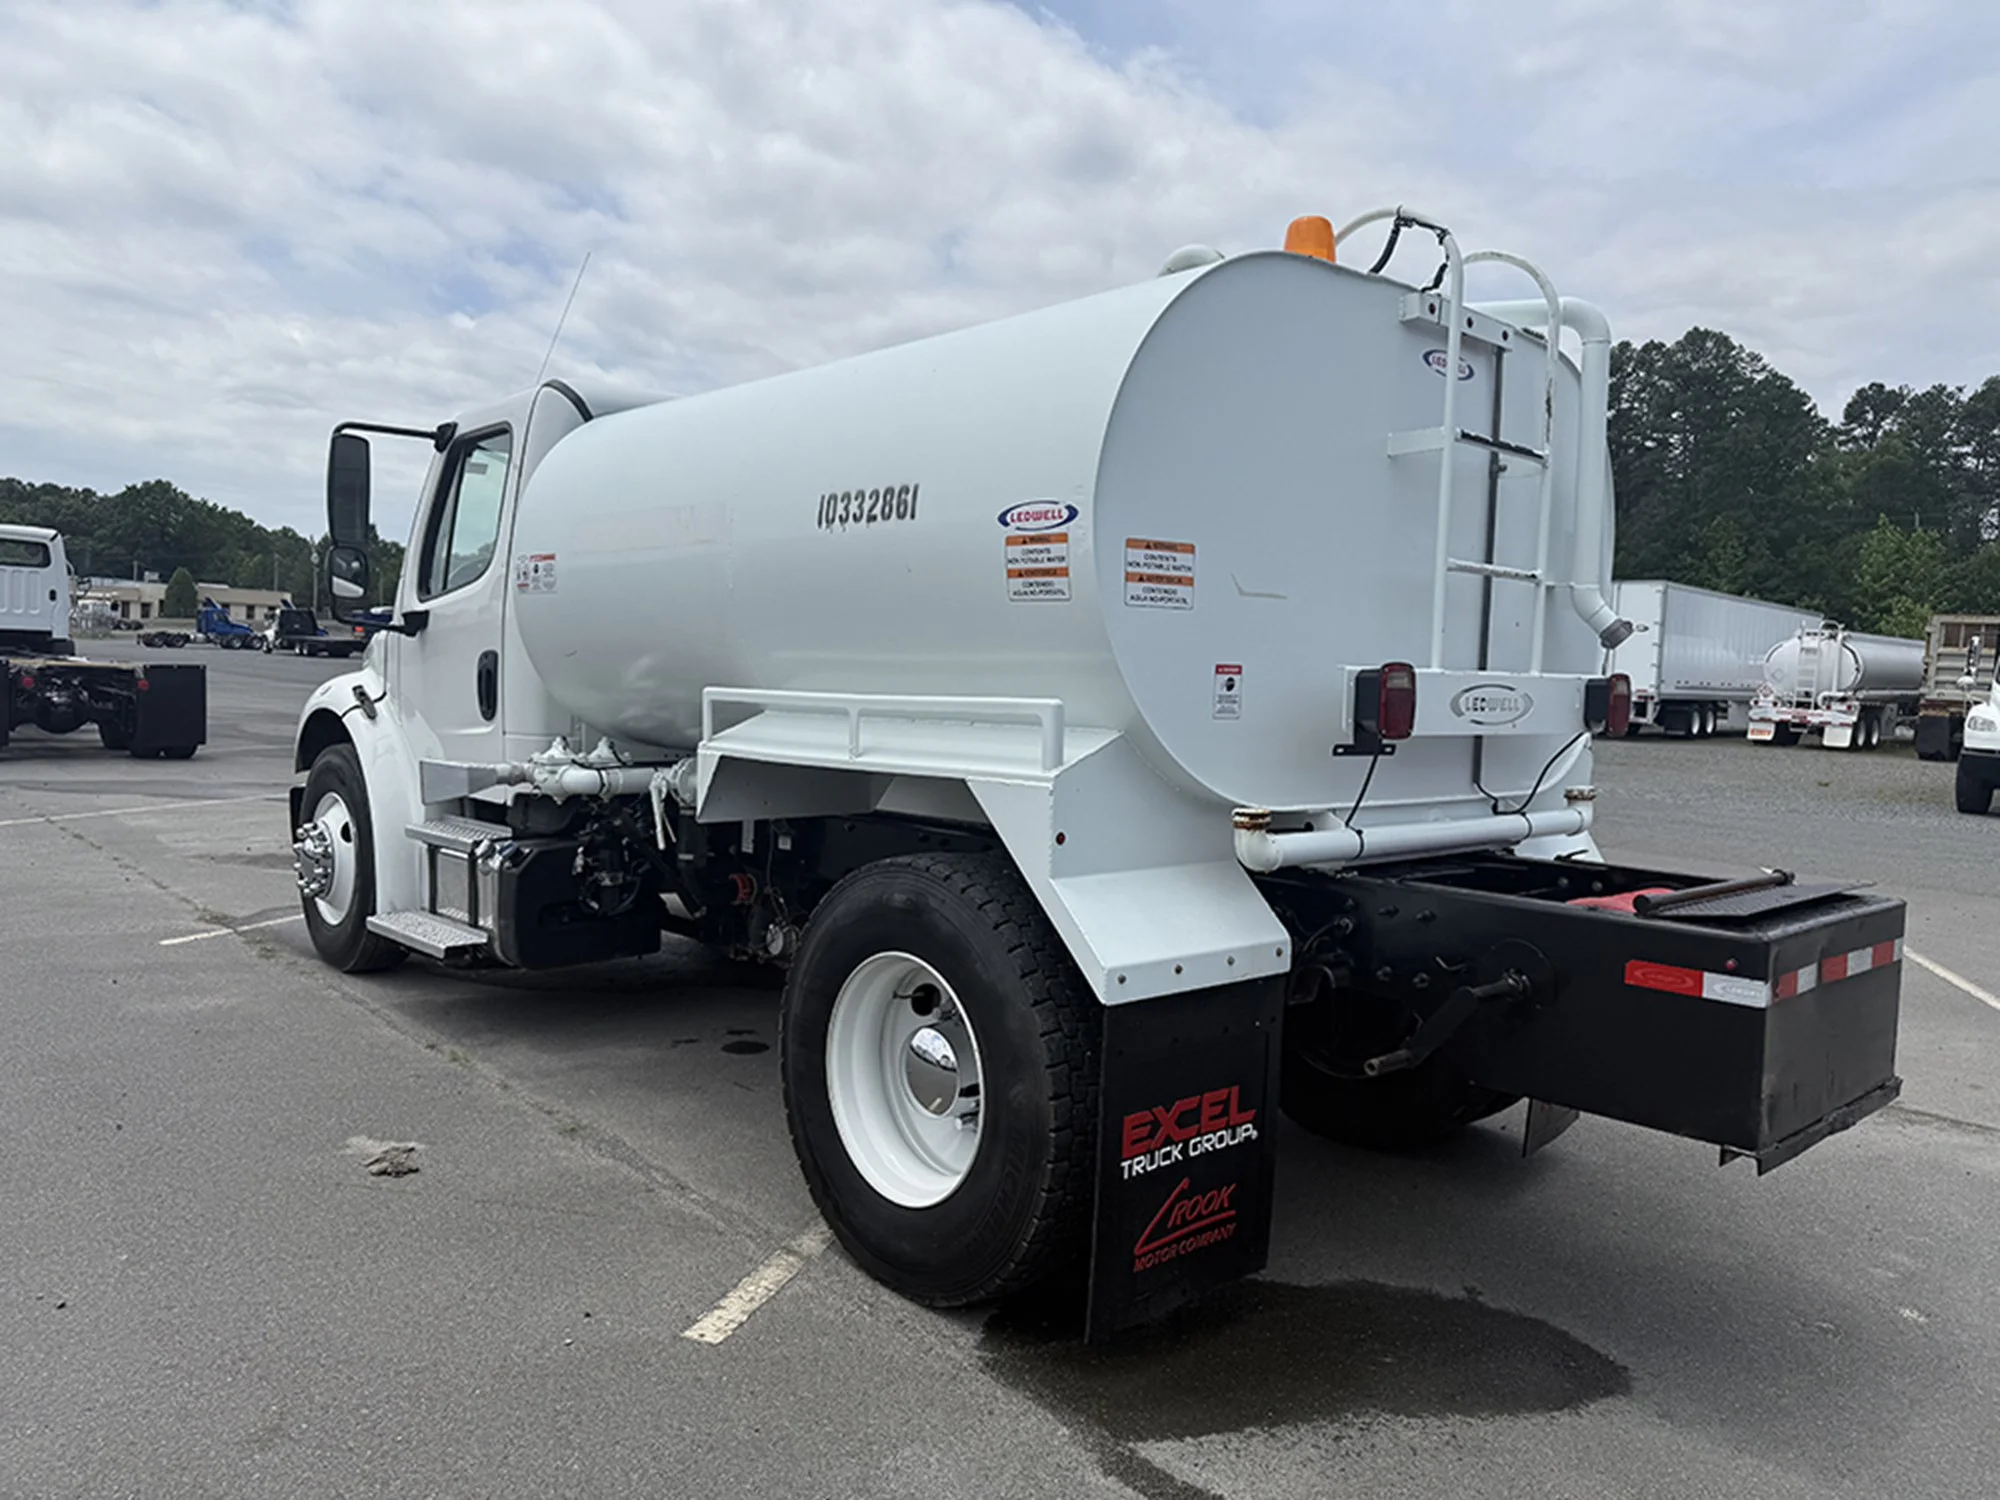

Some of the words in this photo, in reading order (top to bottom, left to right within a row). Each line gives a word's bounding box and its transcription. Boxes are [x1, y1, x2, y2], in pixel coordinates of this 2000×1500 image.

[1431, 355, 1467, 376] LEDLL
[817, 484, 919, 529] 10332861
[1010, 509, 1064, 523] LEDWELL
[1121, 1085, 1257, 1159] EXCEL
[1121, 1142, 1183, 1180] TRUCK
[1133, 1244, 1178, 1273] MOTOR
[1180, 1222, 1236, 1255] COMPANY
